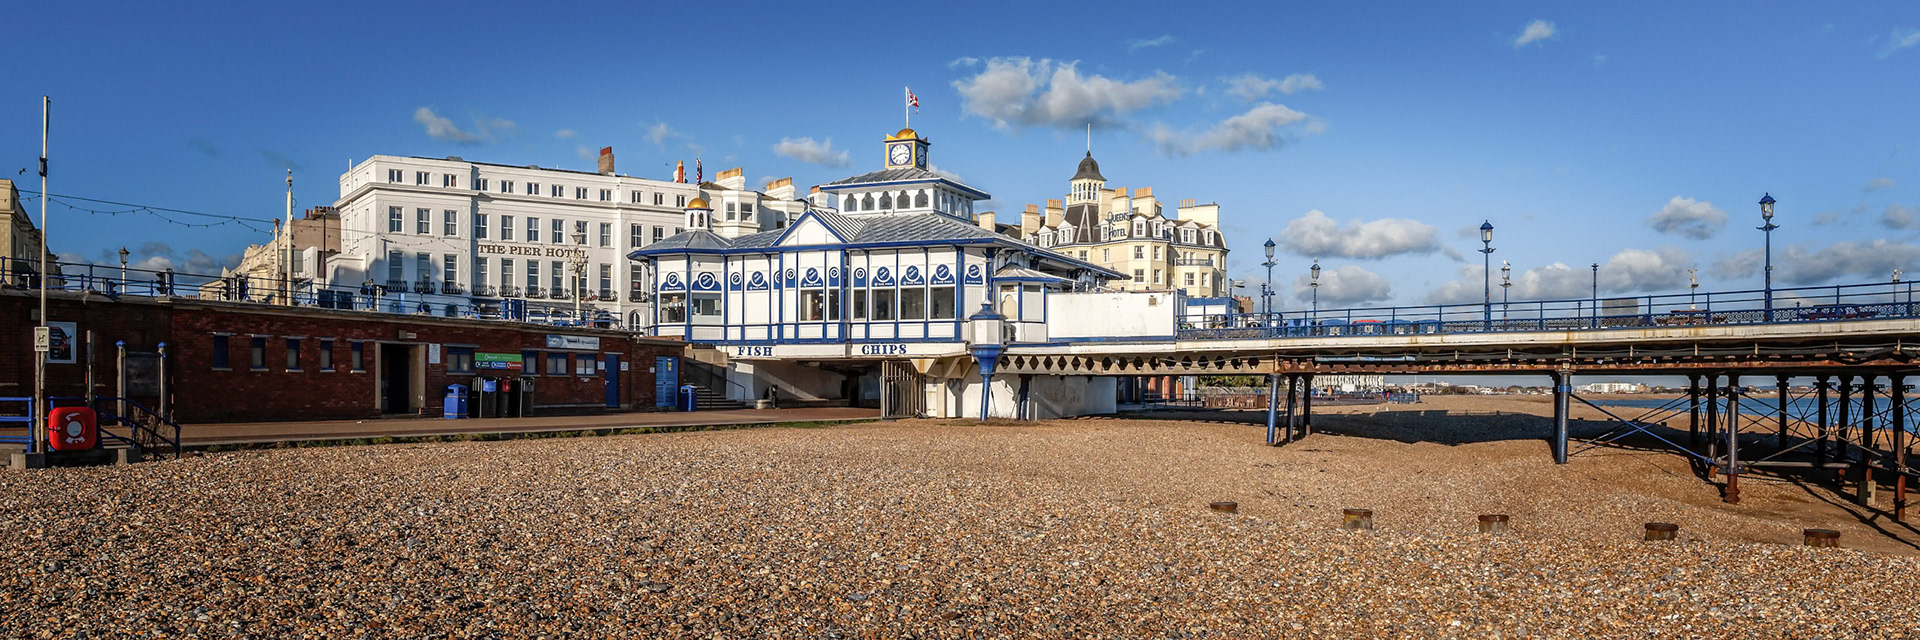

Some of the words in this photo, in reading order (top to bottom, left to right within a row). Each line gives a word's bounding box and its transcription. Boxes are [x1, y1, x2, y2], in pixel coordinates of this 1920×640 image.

[1109, 226, 1127, 238] HOTEL
[478, 244, 506, 254] THE
[509, 245, 541, 256] PIER
[738, 346, 773, 356] FISH
[861, 344, 907, 355] CHIPS
